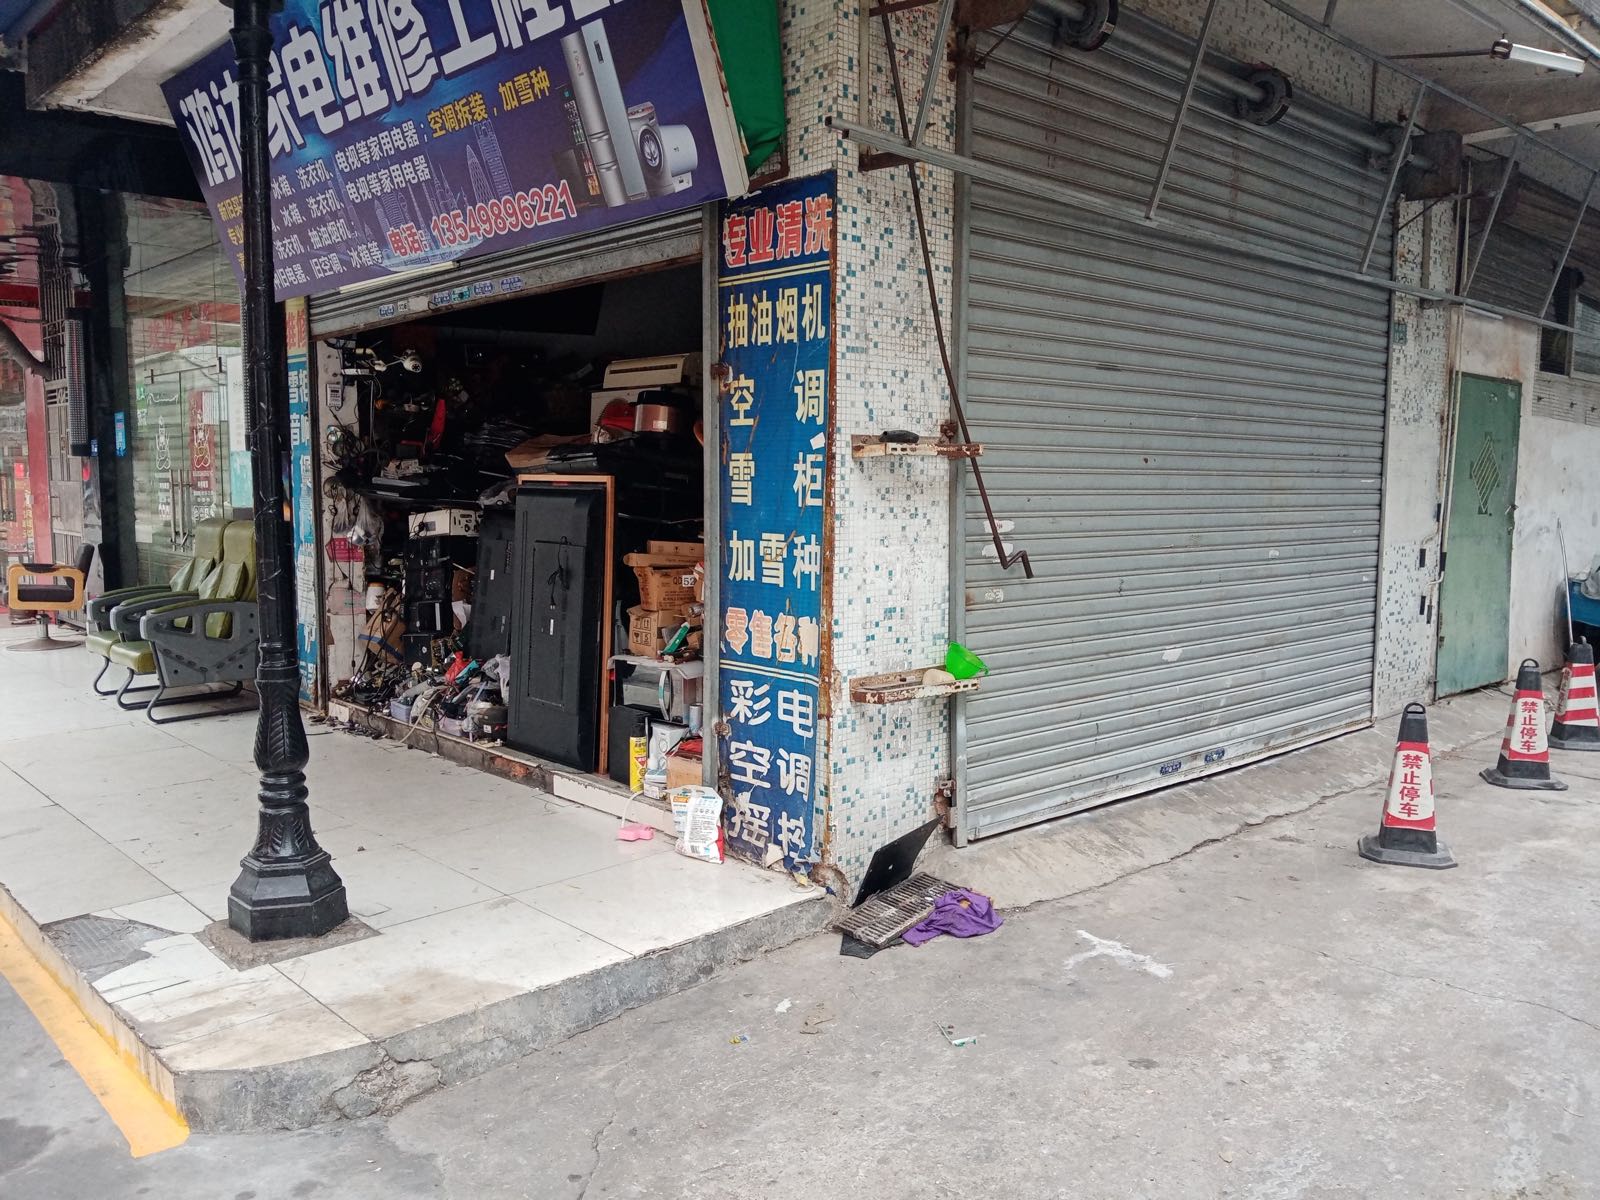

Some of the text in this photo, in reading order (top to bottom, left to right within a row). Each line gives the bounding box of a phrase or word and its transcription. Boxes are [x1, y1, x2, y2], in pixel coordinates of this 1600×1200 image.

[431, 179, 577, 248] 13549896221
[723, 193, 833, 268] 专业清洗
[728, 283, 826, 349] 抽油烟机
[729, 369, 825, 426] 空调
[729, 452, 822, 508] 雪柜
[728, 530, 821, 591] 加雪种
[729, 679, 814, 739] 彩电
[1520, 701, 1538, 752] 禁止停车
[729, 740, 812, 802] 空调
[1399, 753, 1423, 818] 禁止停车
